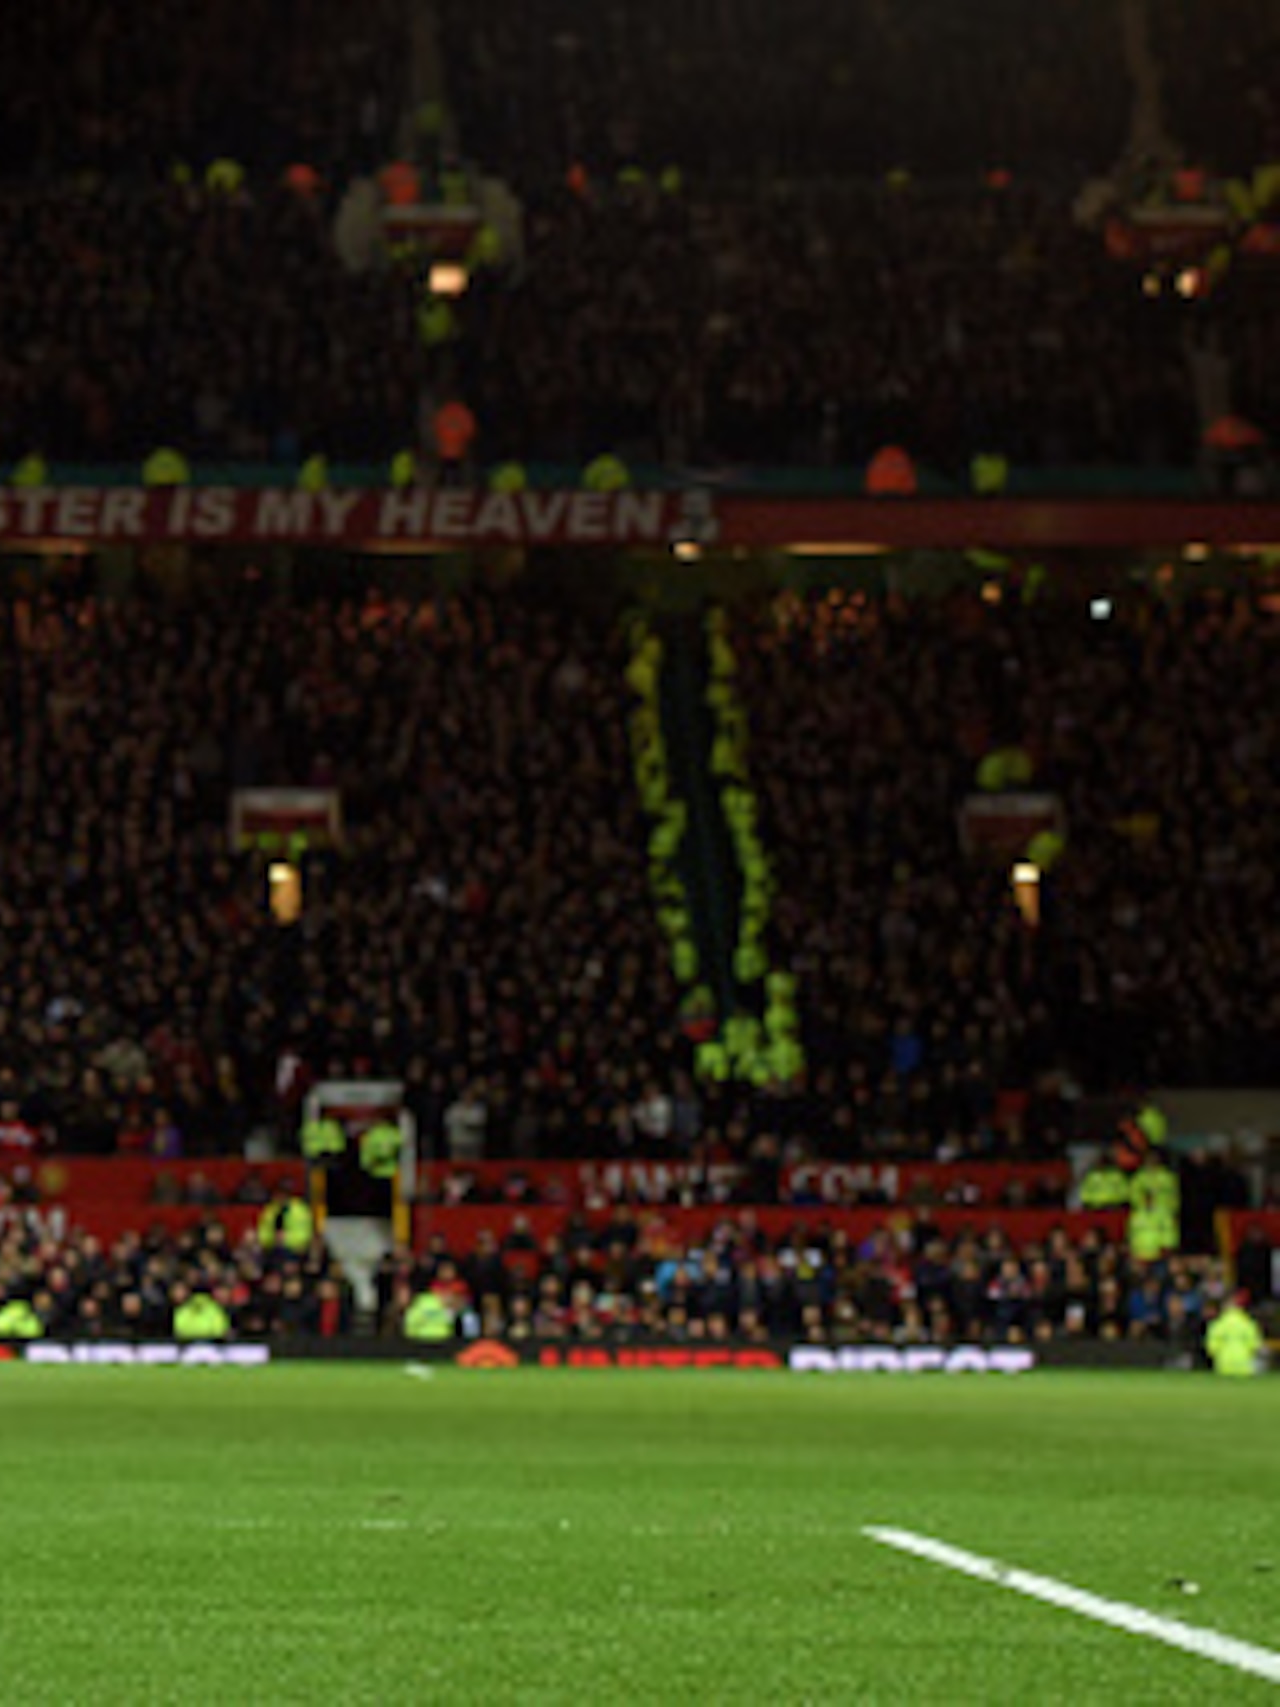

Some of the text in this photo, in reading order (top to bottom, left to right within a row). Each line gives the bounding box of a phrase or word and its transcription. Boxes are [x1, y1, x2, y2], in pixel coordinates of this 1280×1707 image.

[166, 485, 235, 537] IS
[251, 485, 361, 538] MY
[377, 486, 665, 539] HEAVEN
